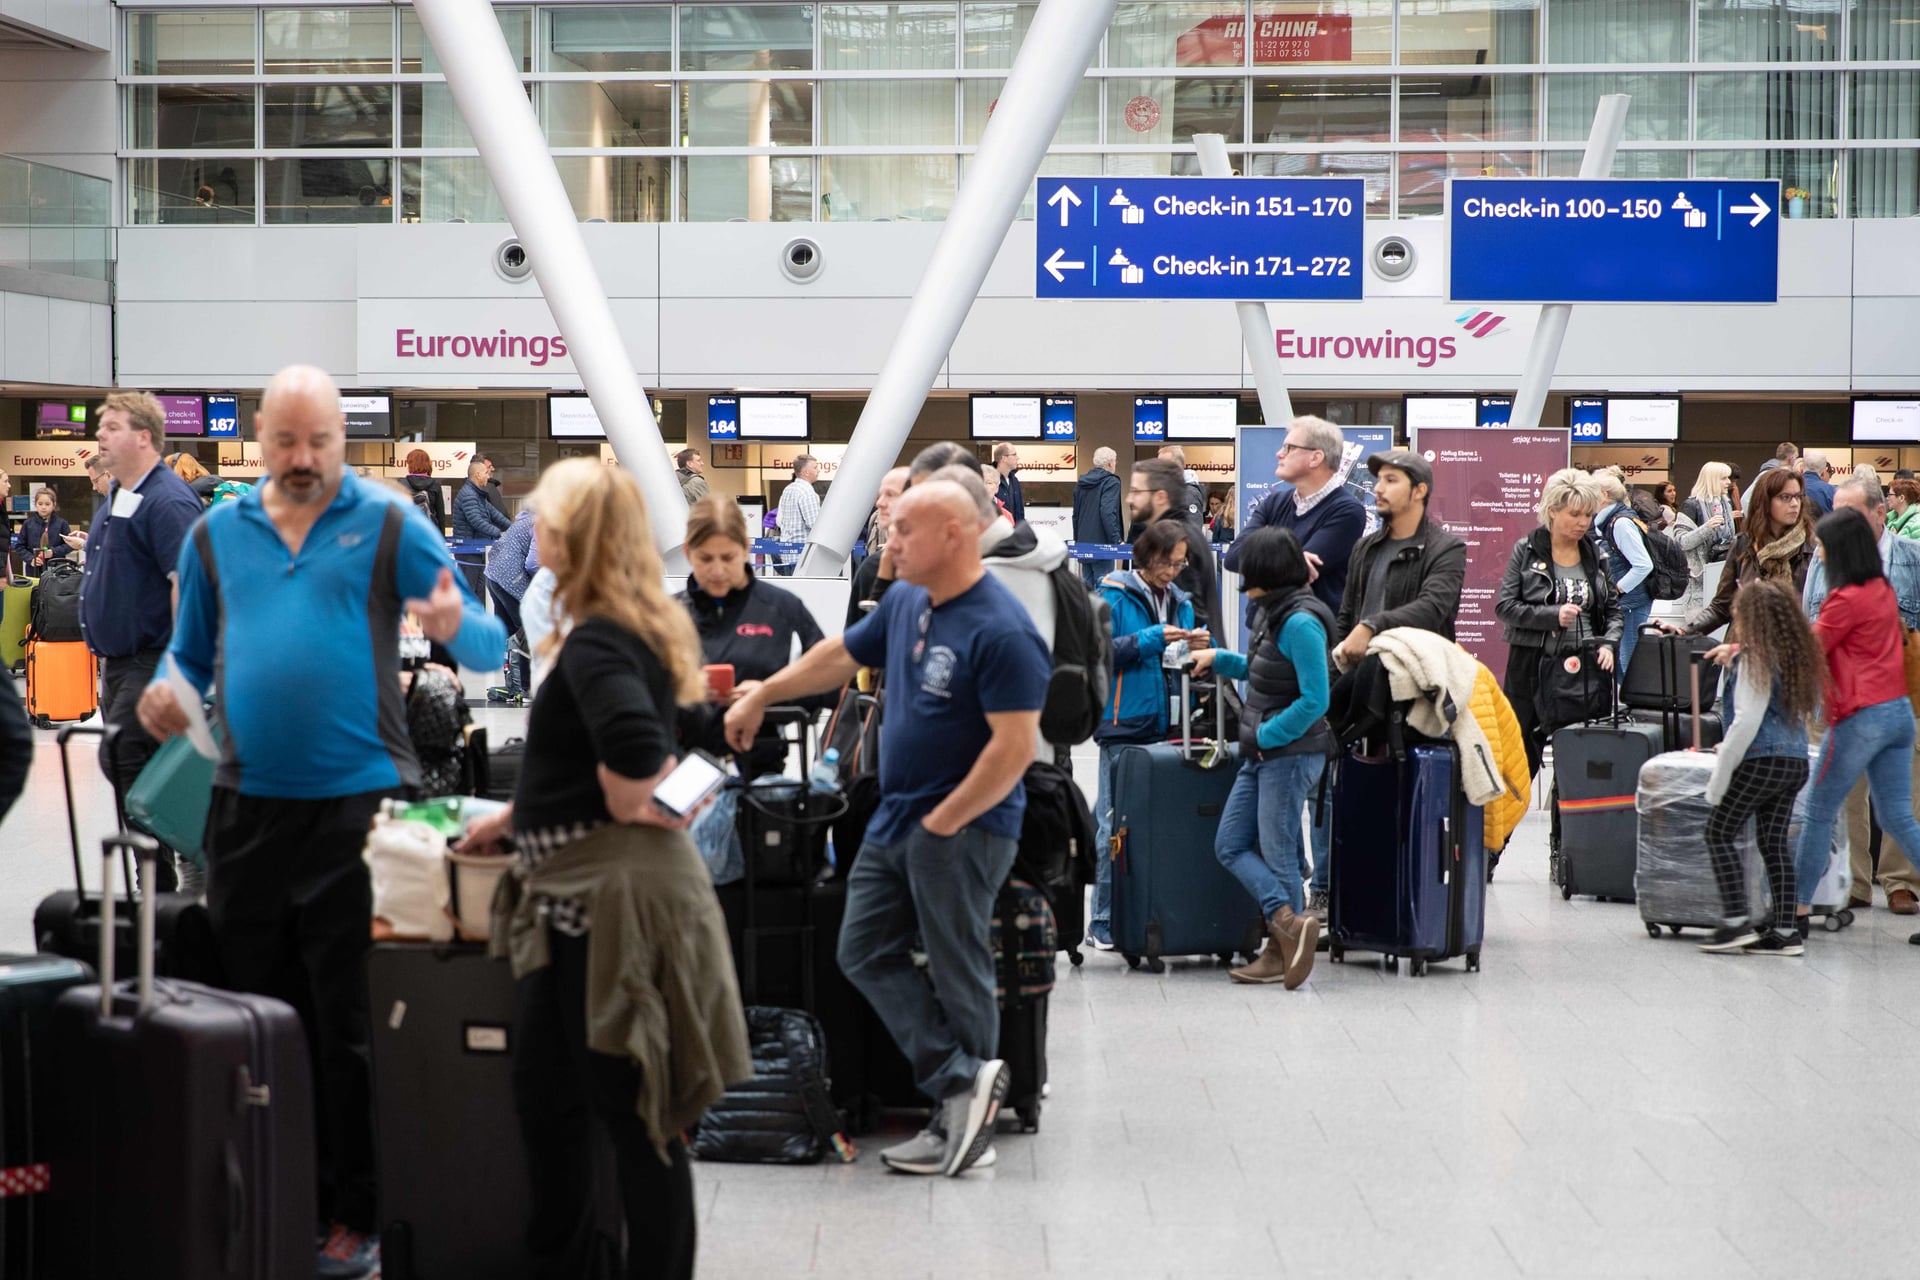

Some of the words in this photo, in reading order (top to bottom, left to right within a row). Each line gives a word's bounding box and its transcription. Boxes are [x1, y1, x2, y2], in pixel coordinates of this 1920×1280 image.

[1260, 21, 1318, 37] CHINA
[1232, 41, 1243, 49] Tel
[1279, 41, 1289, 49] 97
[1292, 41, 1302, 49] 97
[1304, 41, 1310, 49] 0
[1232, 50, 1243, 58] Tel
[1279, 50, 1289, 58] 07
[1292, 50, 1302, 58] 35
[1304, 50, 1310, 58] 0
[1153, 195, 1250, 216] Check-in
[1463, 198, 1560, 218] Check-in
[1152, 255, 1249, 276] Check-in
[396, 329, 567, 367] Eurowings
[1275, 329, 1457, 368] Eurowings
[209, 418, 236, 431] 167
[709, 420, 737, 433] 164
[1046, 421, 1073, 434] 163
[1135, 421, 1163, 434] 162
[1573, 423, 1601, 436] 160
[14, 455, 76, 469] Eurowings
[222, 457, 265, 468] Eurowi
